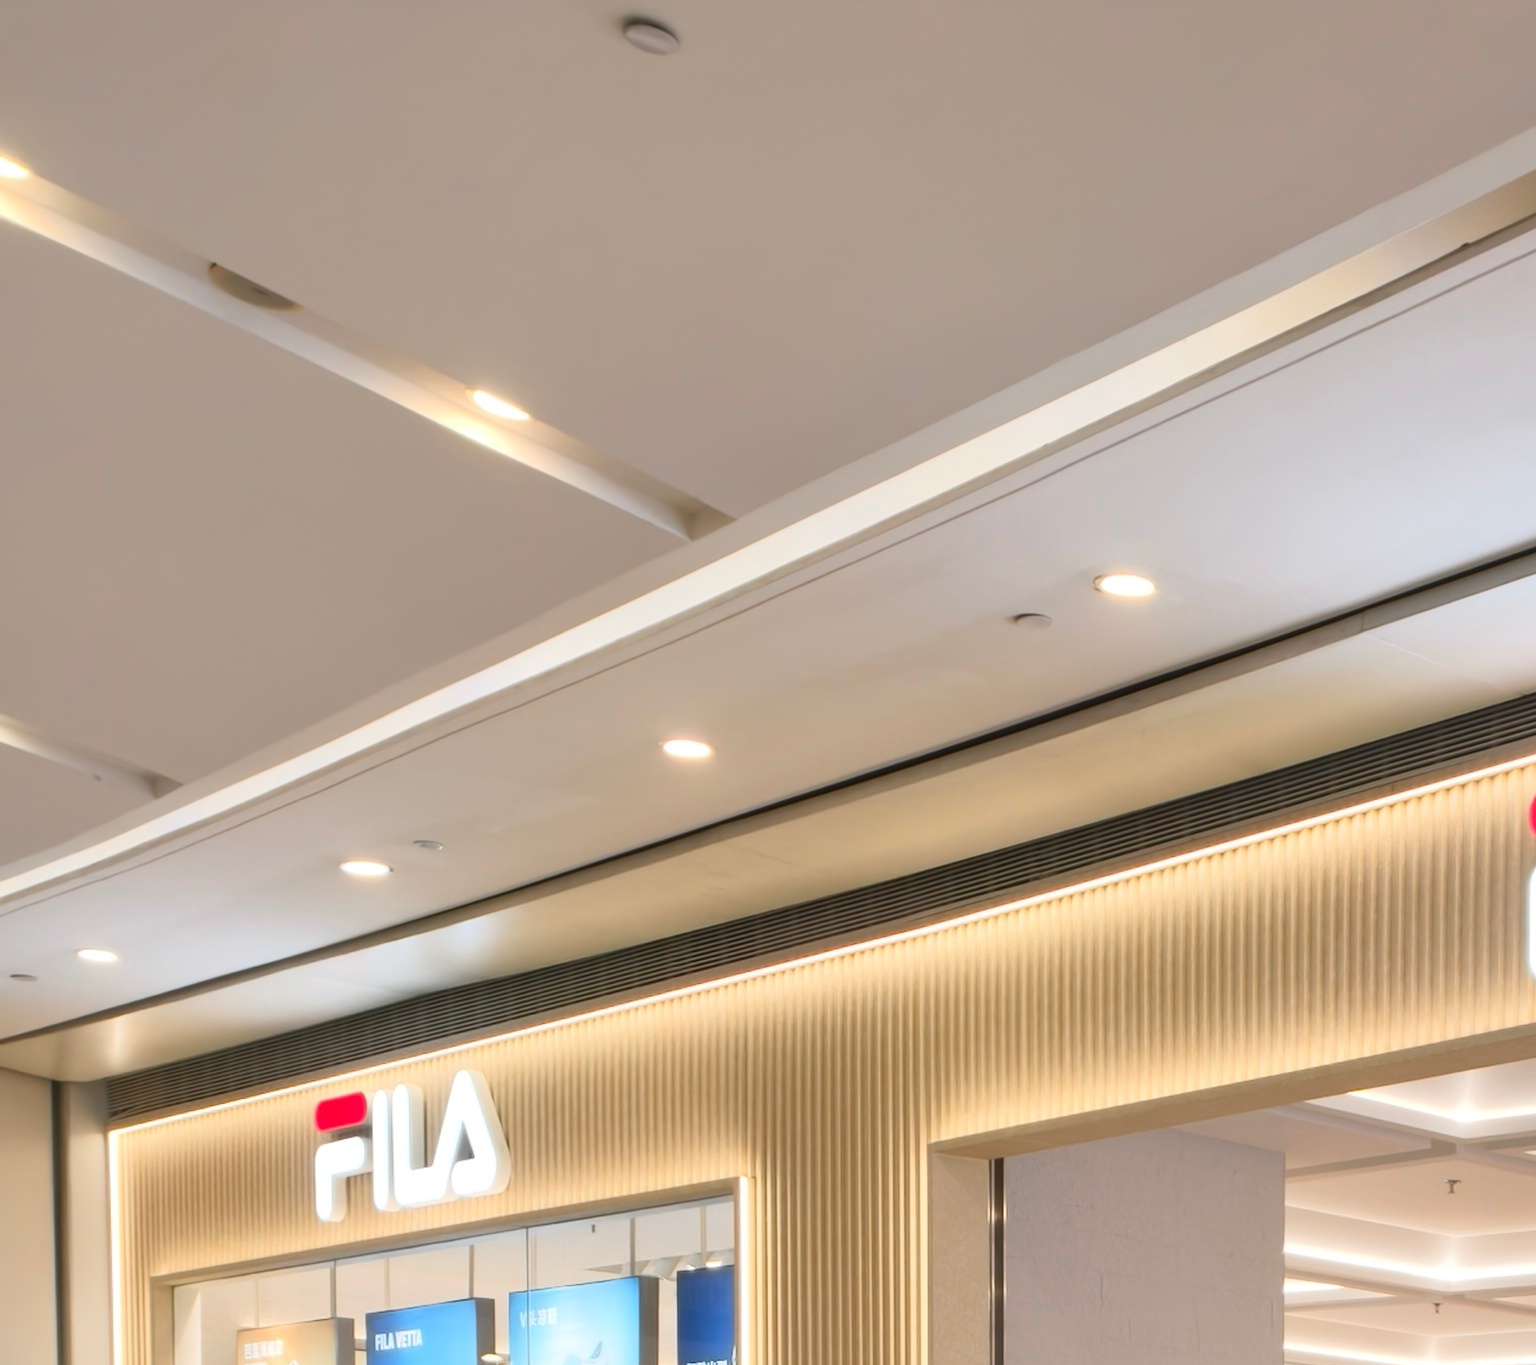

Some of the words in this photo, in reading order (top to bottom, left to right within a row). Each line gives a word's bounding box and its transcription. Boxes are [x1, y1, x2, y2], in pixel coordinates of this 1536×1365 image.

[314, 1069, 511, 1222] FILA
[375, 1332, 395, 1351] FILA
[396, 1329, 423, 1349] VETTA
